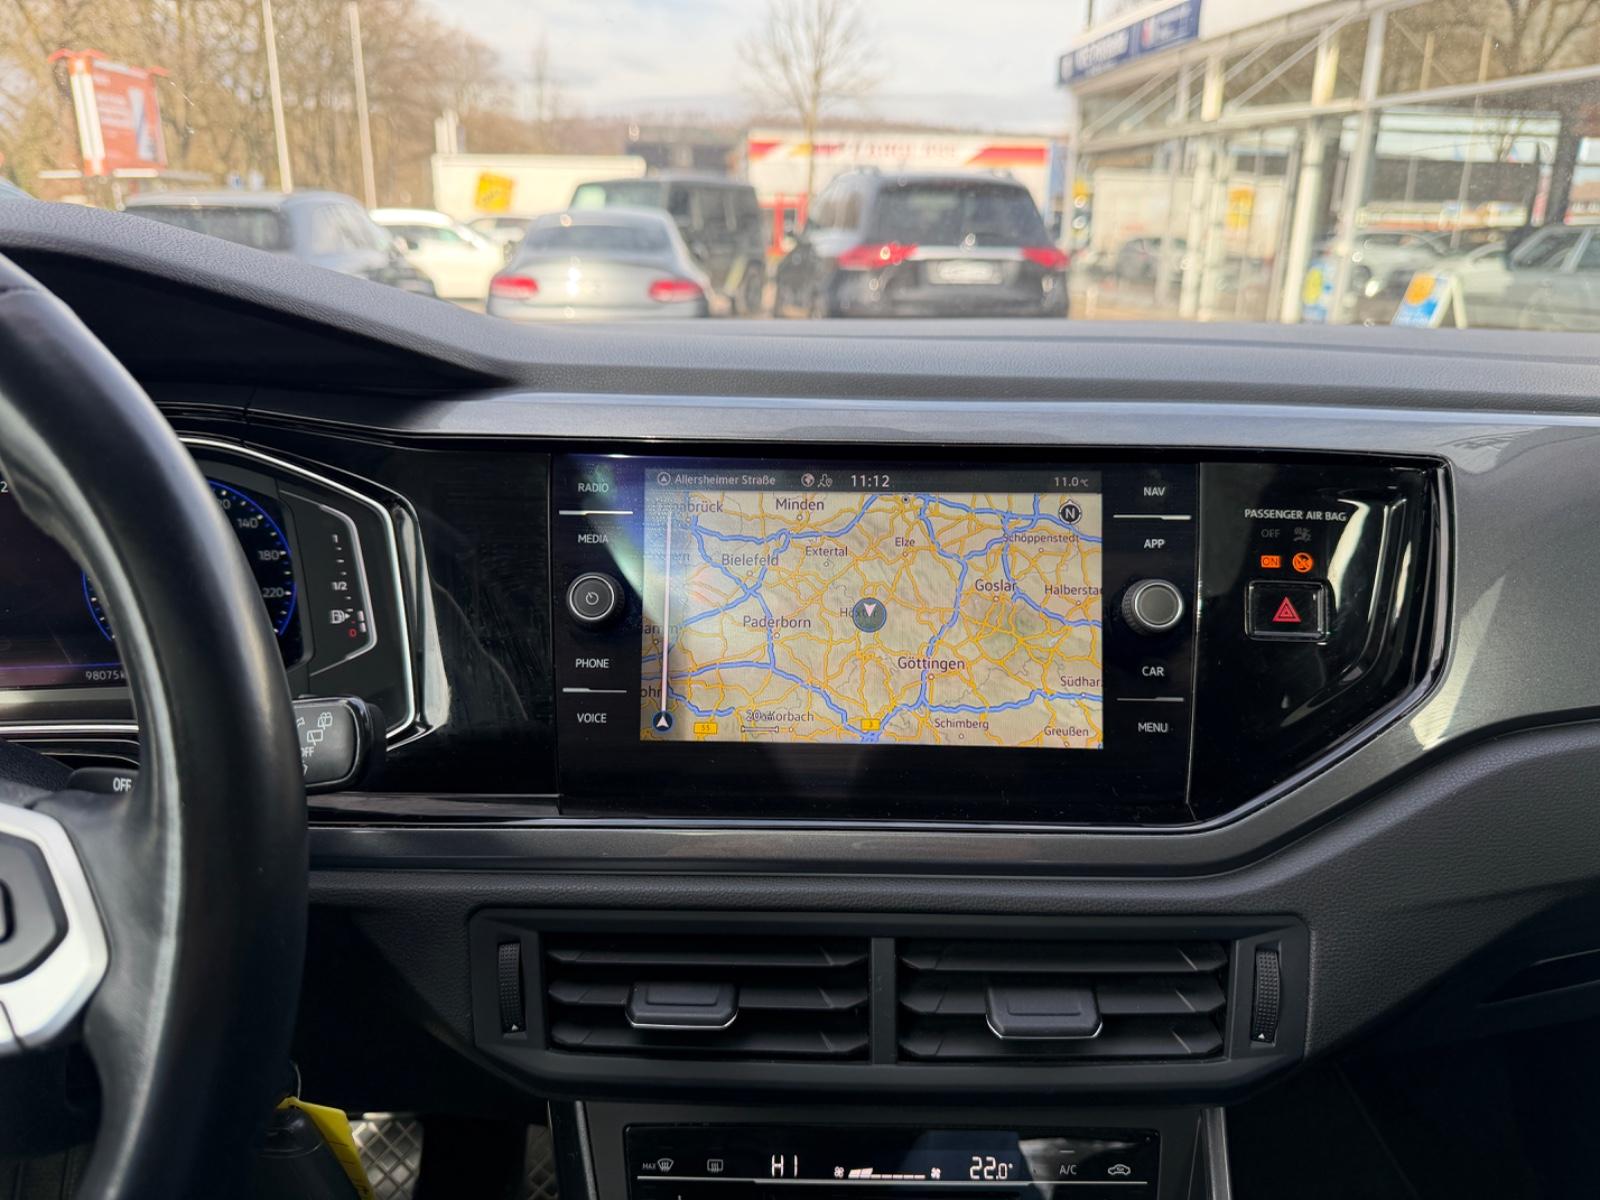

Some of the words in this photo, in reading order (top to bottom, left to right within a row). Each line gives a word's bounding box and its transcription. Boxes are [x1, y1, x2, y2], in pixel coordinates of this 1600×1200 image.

[675, 475, 739, 485] Allersheimer
[742, 475, 776, 486] Straße
[851, 475, 890, 488] 11:12
[577, 482, 609, 493] RADIO
[1143, 486, 1166, 496] NAV
[775, 498, 824, 511] Minden
[1065, 507, 1076, 519] N
[1244, 508, 1303, 520] PASSENGER
[1306, 511, 1323, 521] AIR
[1325, 512, 1347, 522] BAG
[237, 518, 259, 528] 140
[577, 533, 609, 544] MEDIA
[1260, 528, 1280, 538] OFF
[894, 536, 916, 548] Elze
[1143, 538, 1166, 549] APP
[258, 551, 279, 561] 180
[805, 546, 848, 557] Extertal
[721, 553, 779, 567] Bielefeld
[1262, 556, 1278, 566] ON
[332, 581, 348, 591] 1/2
[975, 578, 1017, 592] Goslar
[263, 588, 284, 598] 220
[743, 615, 812, 629] Paderborn
[575, 658, 610, 669] PHONE
[897, 656, 966, 670] Göttingen
[1141, 666, 1165, 677] CAR
[576, 712, 607, 723] VOICE
[934, 717, 990, 730] Schimberg
[1137, 721, 1169, 733] MENU
[1044, 725, 1089, 737] Greußen
[112, 777, 132, 793] OFF
[642, 1162, 657, 1170] MAX
[1059, 1164, 1077, 1175] A/C
